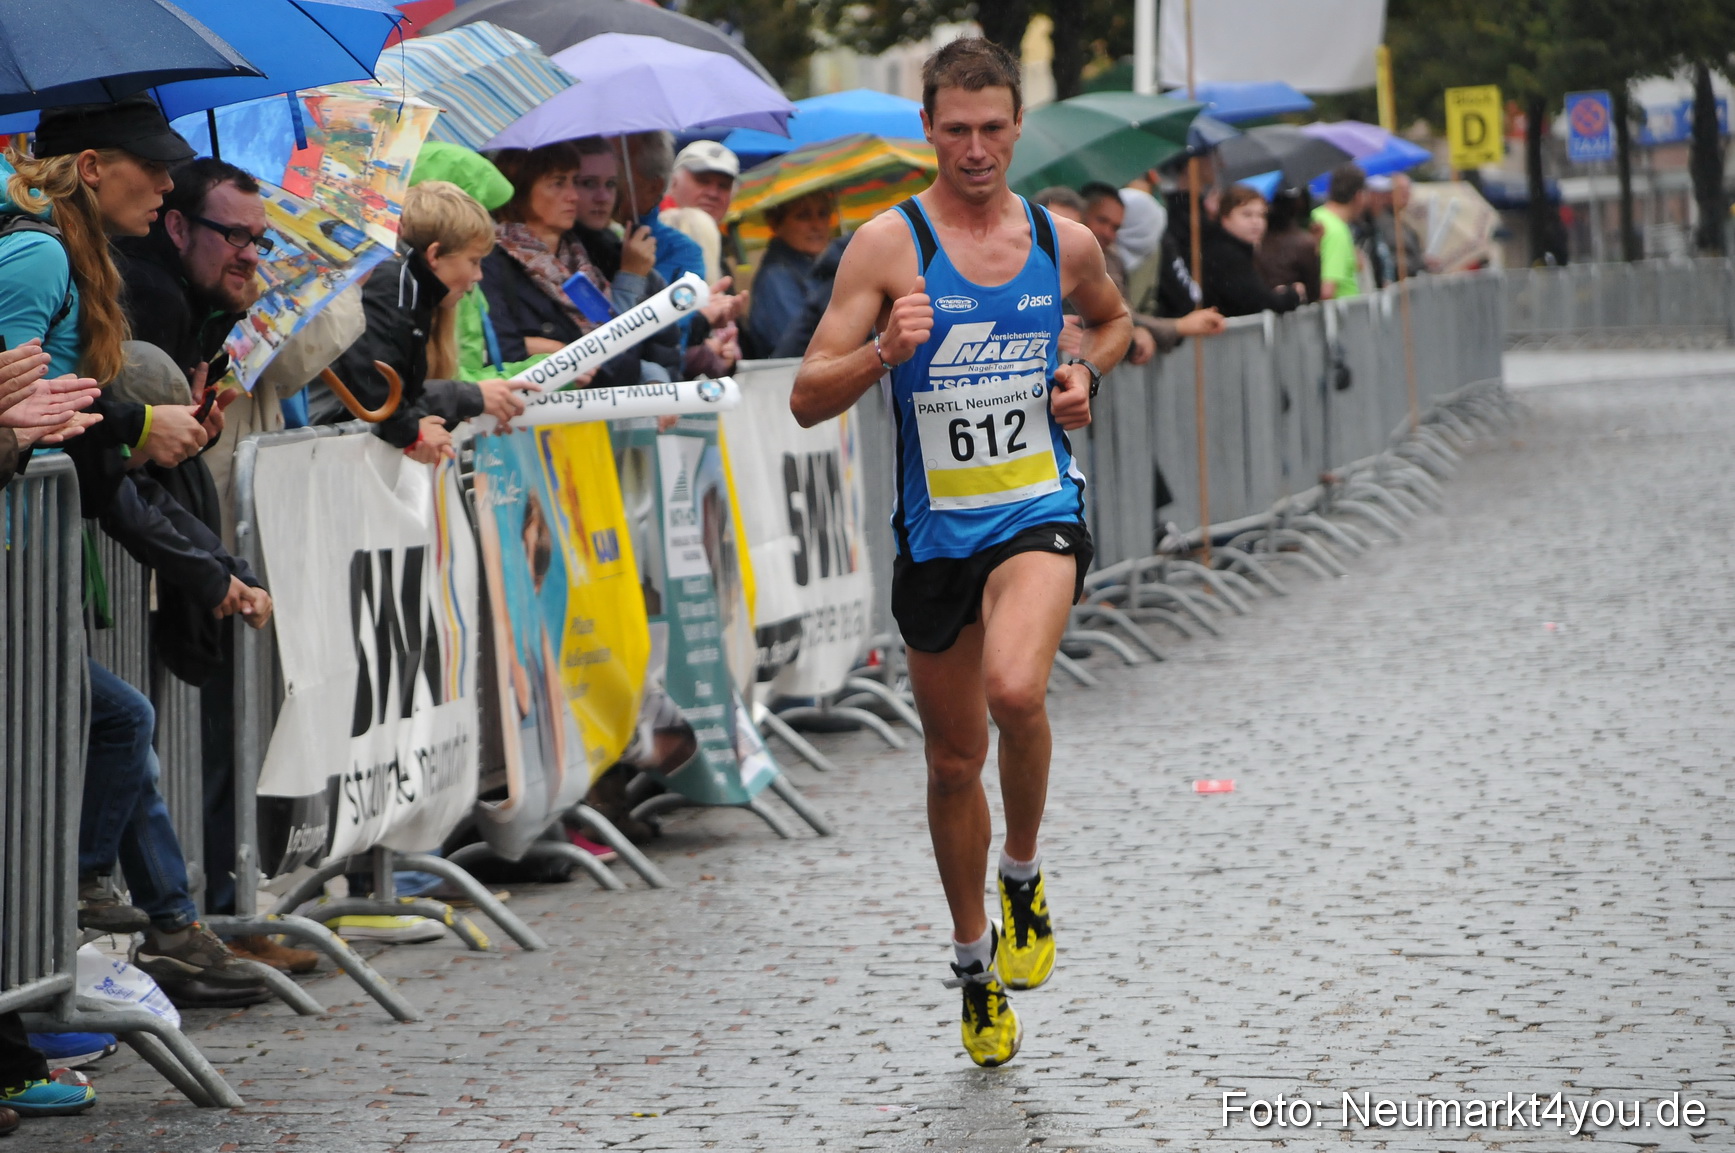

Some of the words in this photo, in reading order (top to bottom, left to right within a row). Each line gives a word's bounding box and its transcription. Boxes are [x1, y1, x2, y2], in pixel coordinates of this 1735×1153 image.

[1462, 112, 1486, 146] D
[1029, 295, 1053, 307] asics
[968, 363, 1014, 372] Nagel-Team
[918, 399, 963, 414] PARTL
[966, 390, 1028, 409] Neumarkt
[948, 408, 1027, 462] 612
